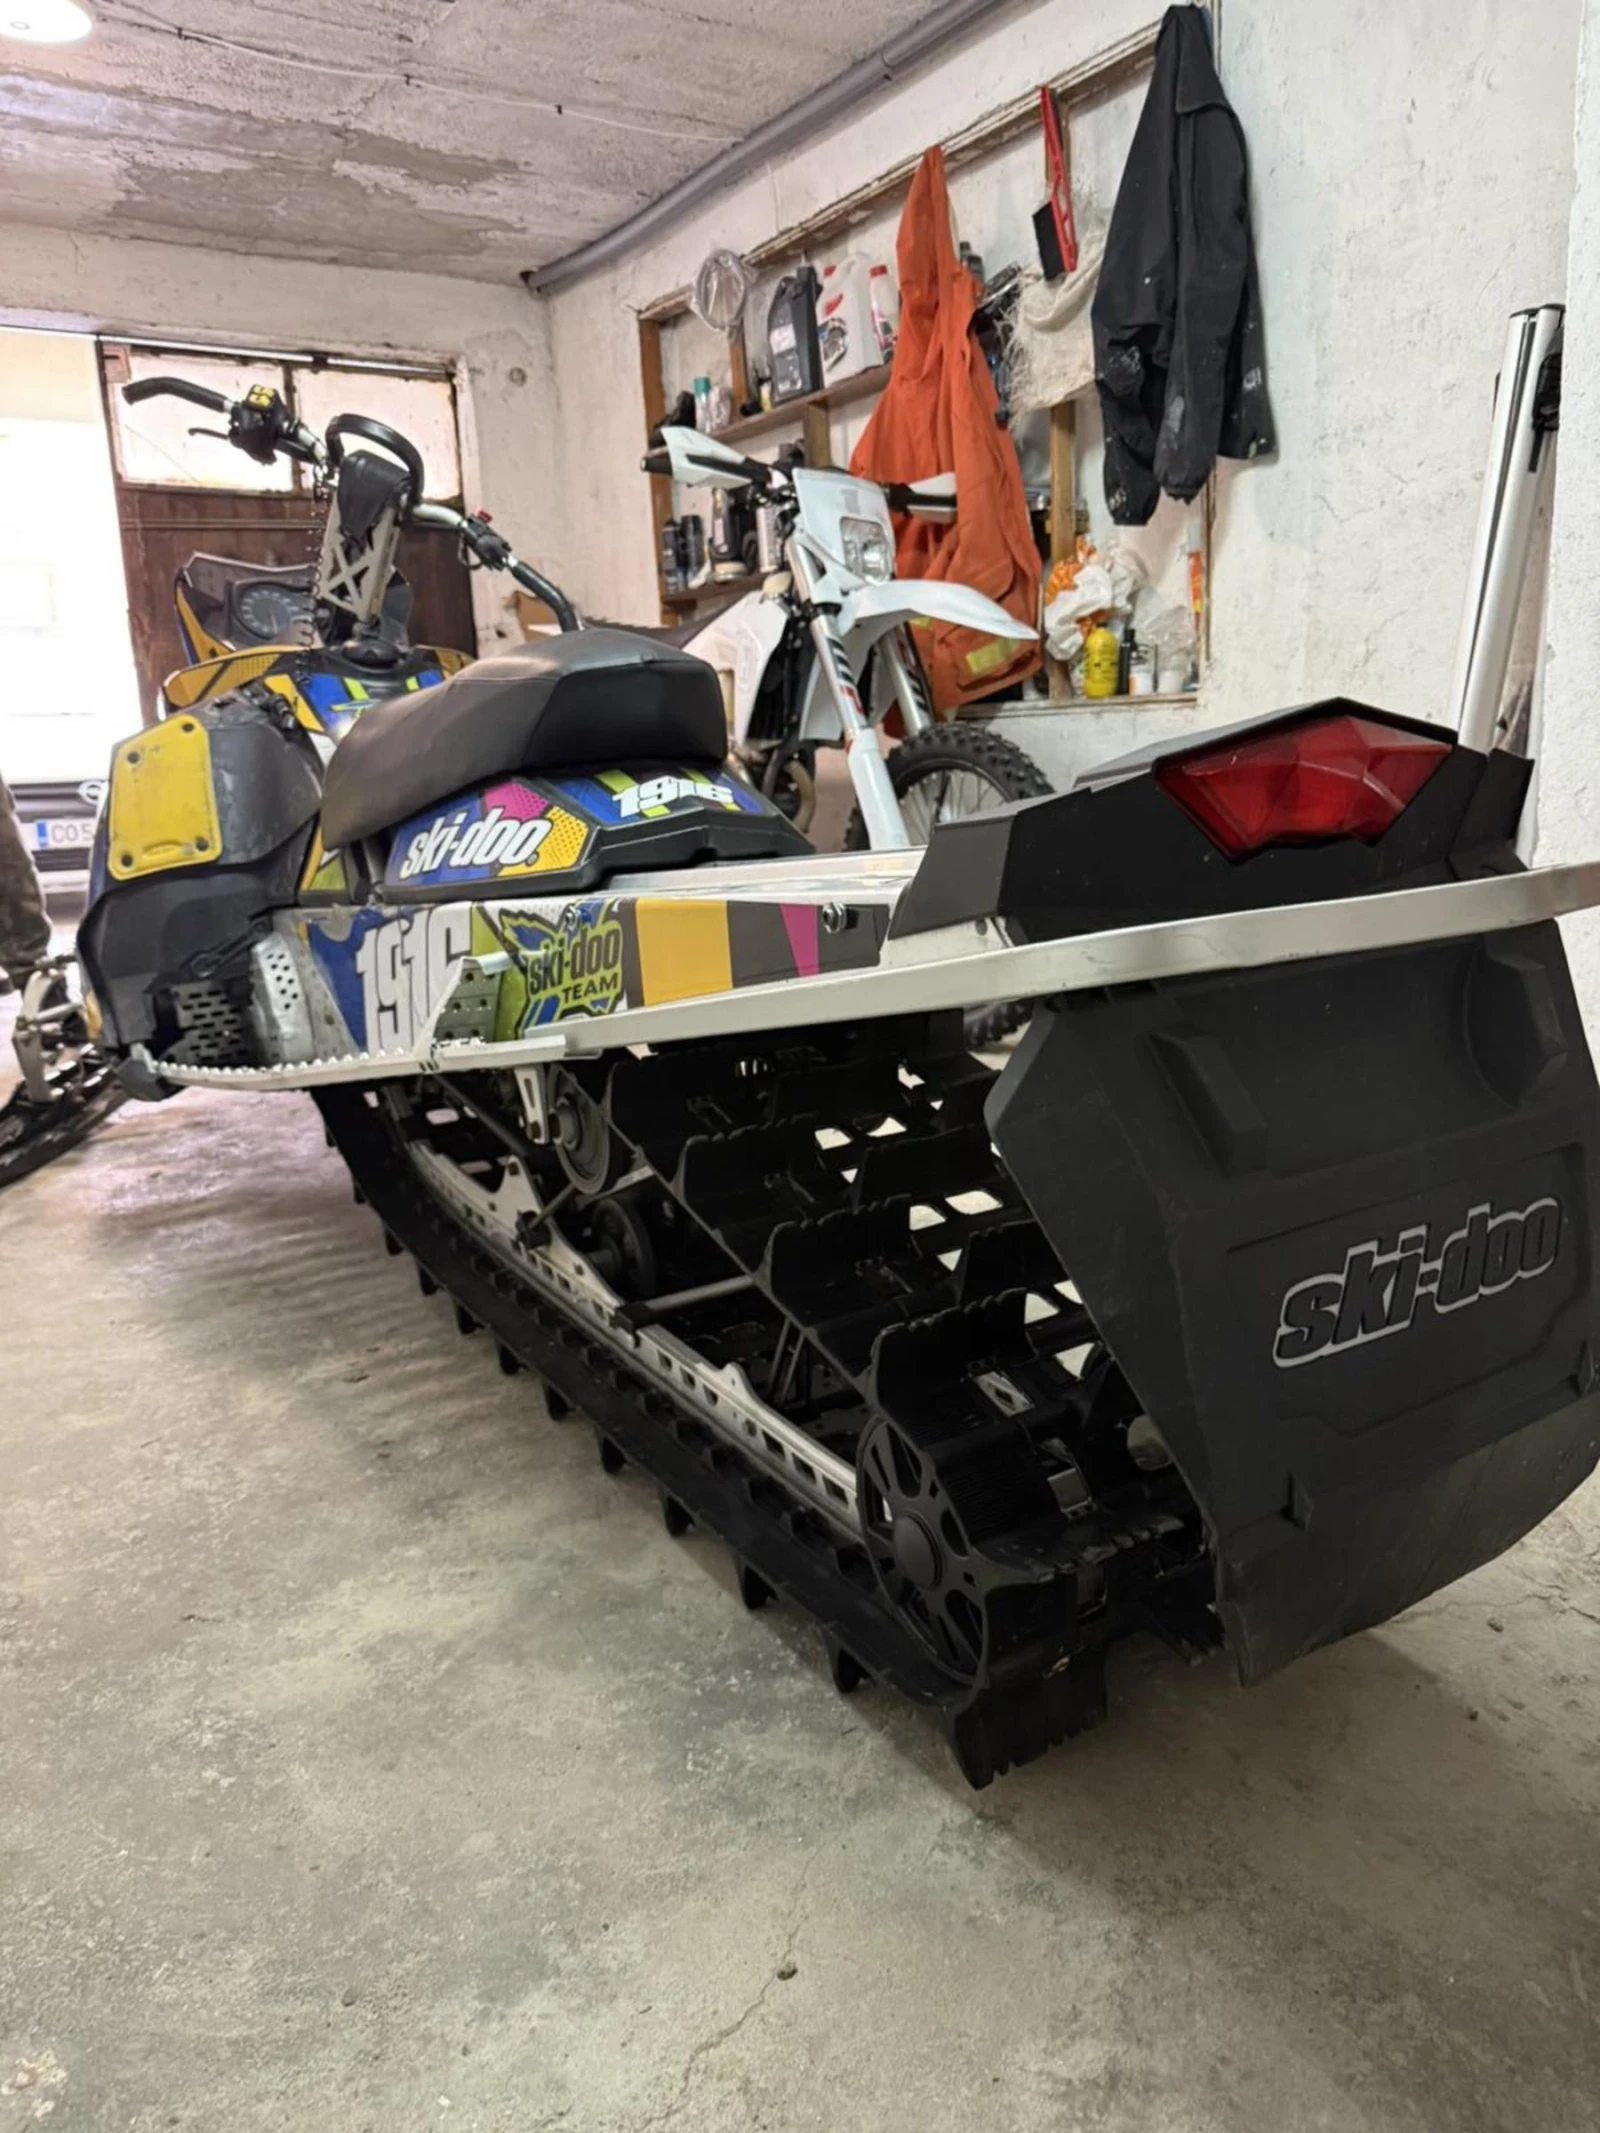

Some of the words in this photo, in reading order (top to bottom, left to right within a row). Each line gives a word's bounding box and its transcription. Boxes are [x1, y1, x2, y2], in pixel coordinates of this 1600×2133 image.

[611, 775, 734, 818] 1916
[561, 972, 619, 1004] TEAM
[1273, 1197, 1561, 1368] ski-doo
